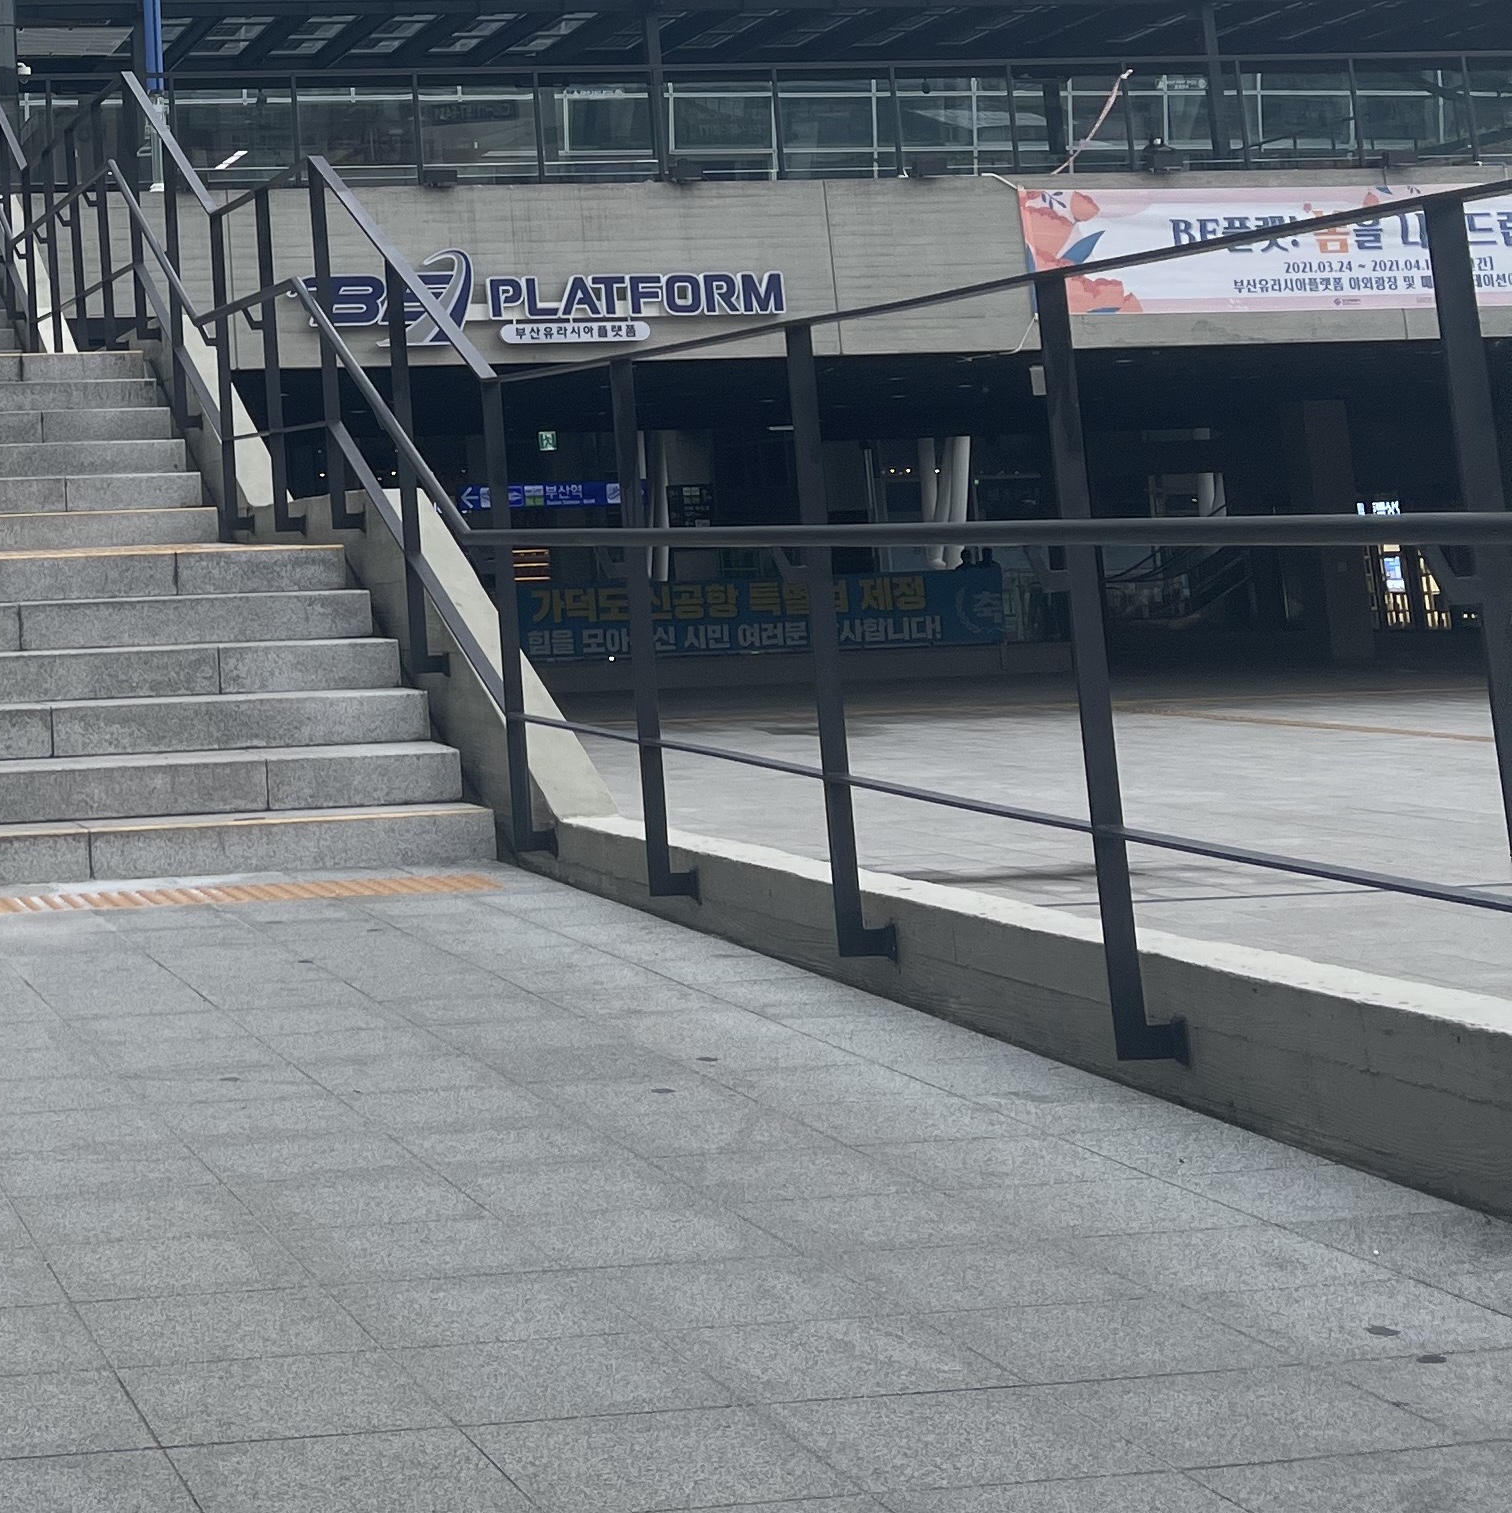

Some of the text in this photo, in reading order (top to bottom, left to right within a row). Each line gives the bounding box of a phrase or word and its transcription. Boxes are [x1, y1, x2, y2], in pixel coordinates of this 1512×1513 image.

[1284, 260, 1353, 274] 2021.03.24
[1233, 276, 1344, 294] 부산유라시아플랫폼
[1349, 275, 1398, 292] 야외광장
[1404, 275, 1415, 290] 및
[488, 271, 786, 321] PLATFORM
[515, 324, 637, 340] 부산유라시아플랫폼
[545, 484, 583, 499] 부산역
[858, 575, 927, 612] 제정
[527, 614, 942, 655] 힘을 모아신 시민 여러분 사합니다!
